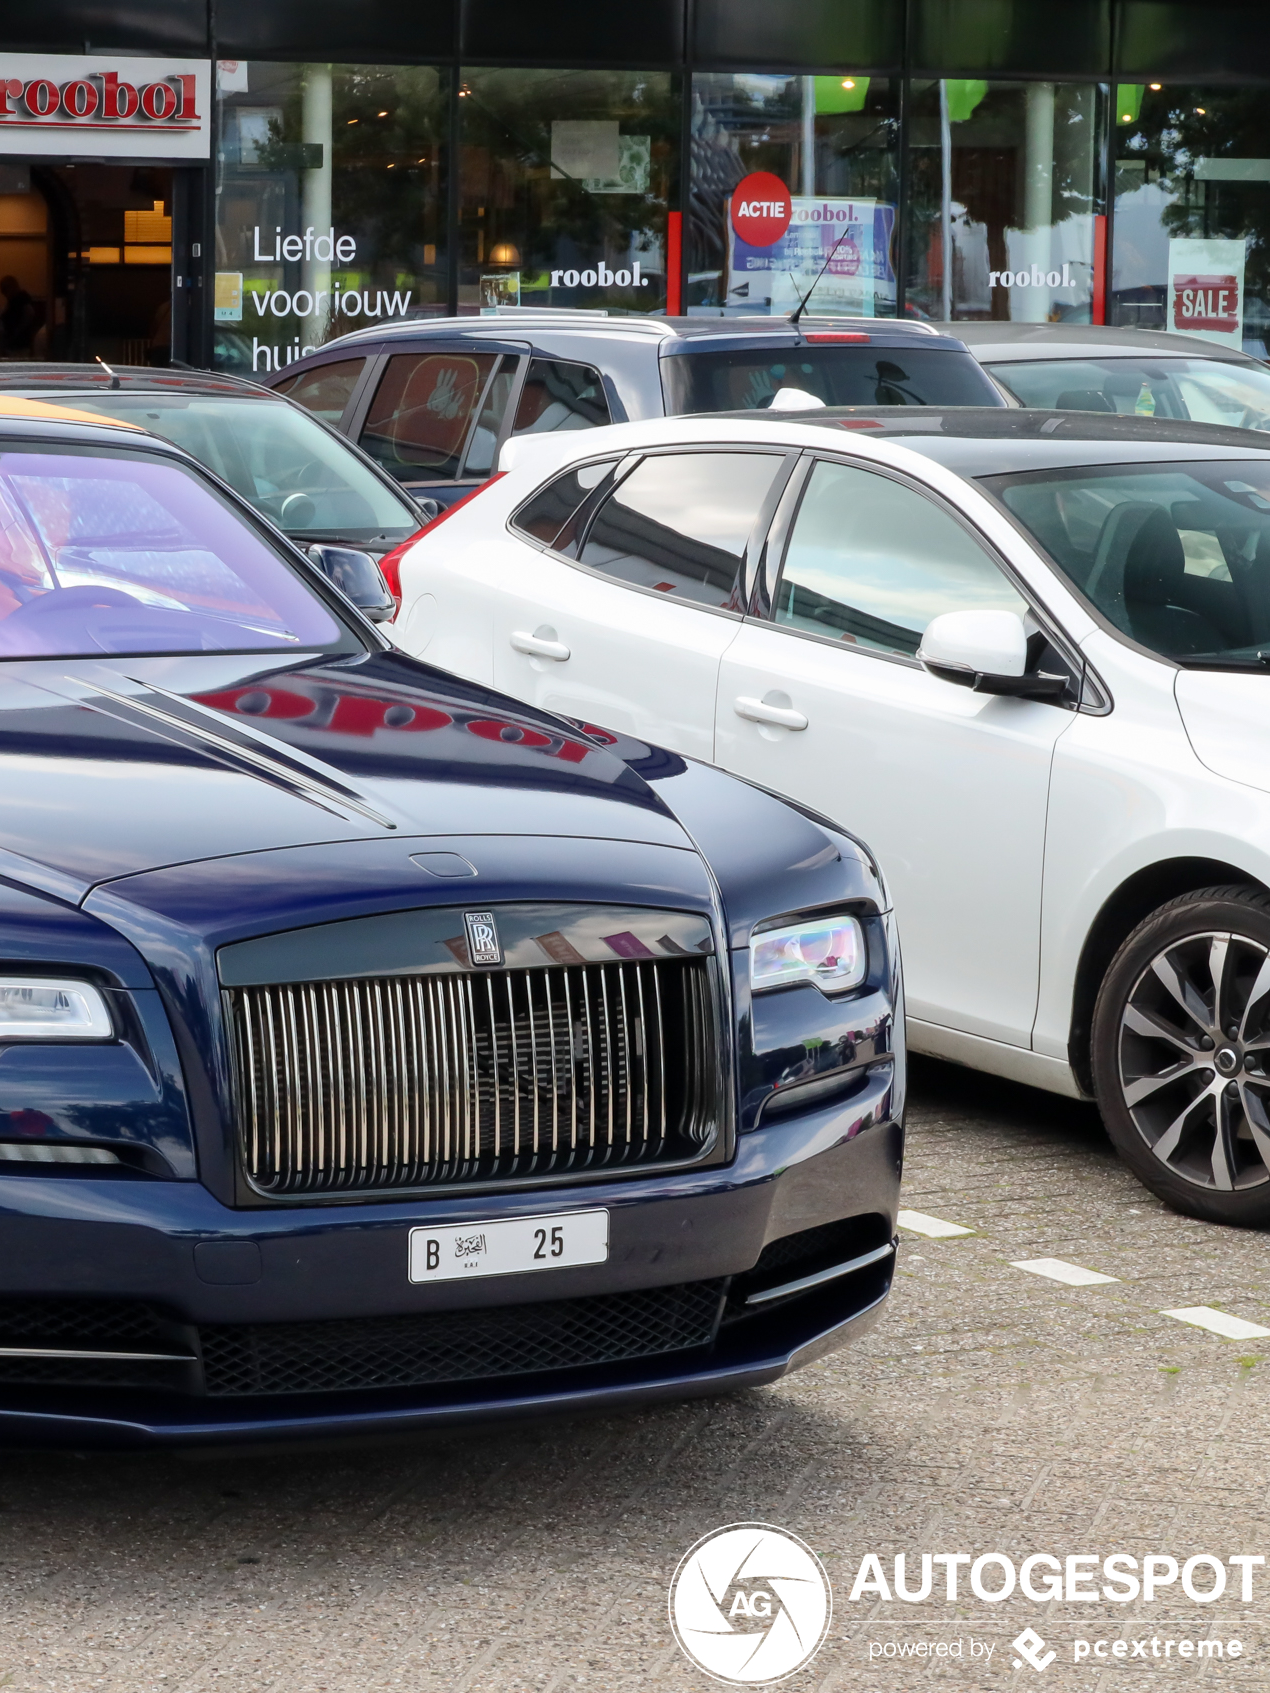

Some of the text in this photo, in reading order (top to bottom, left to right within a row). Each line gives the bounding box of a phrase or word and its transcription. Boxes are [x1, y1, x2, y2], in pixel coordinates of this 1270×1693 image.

[737, 201, 785, 218] ACTIE
[253, 227, 357, 262] Liefde
[550, 261, 649, 287] roobol.
[988, 264, 1077, 288] roobol.
[251, 289, 327, 317] voor
[1182, 289, 1229, 319] SALE
[468, 914, 491, 922] ROLLS
[476, 953, 498, 961] ROYCE
[426, 1239, 440, 1271] B
[533, 1226, 564, 1260] 25
